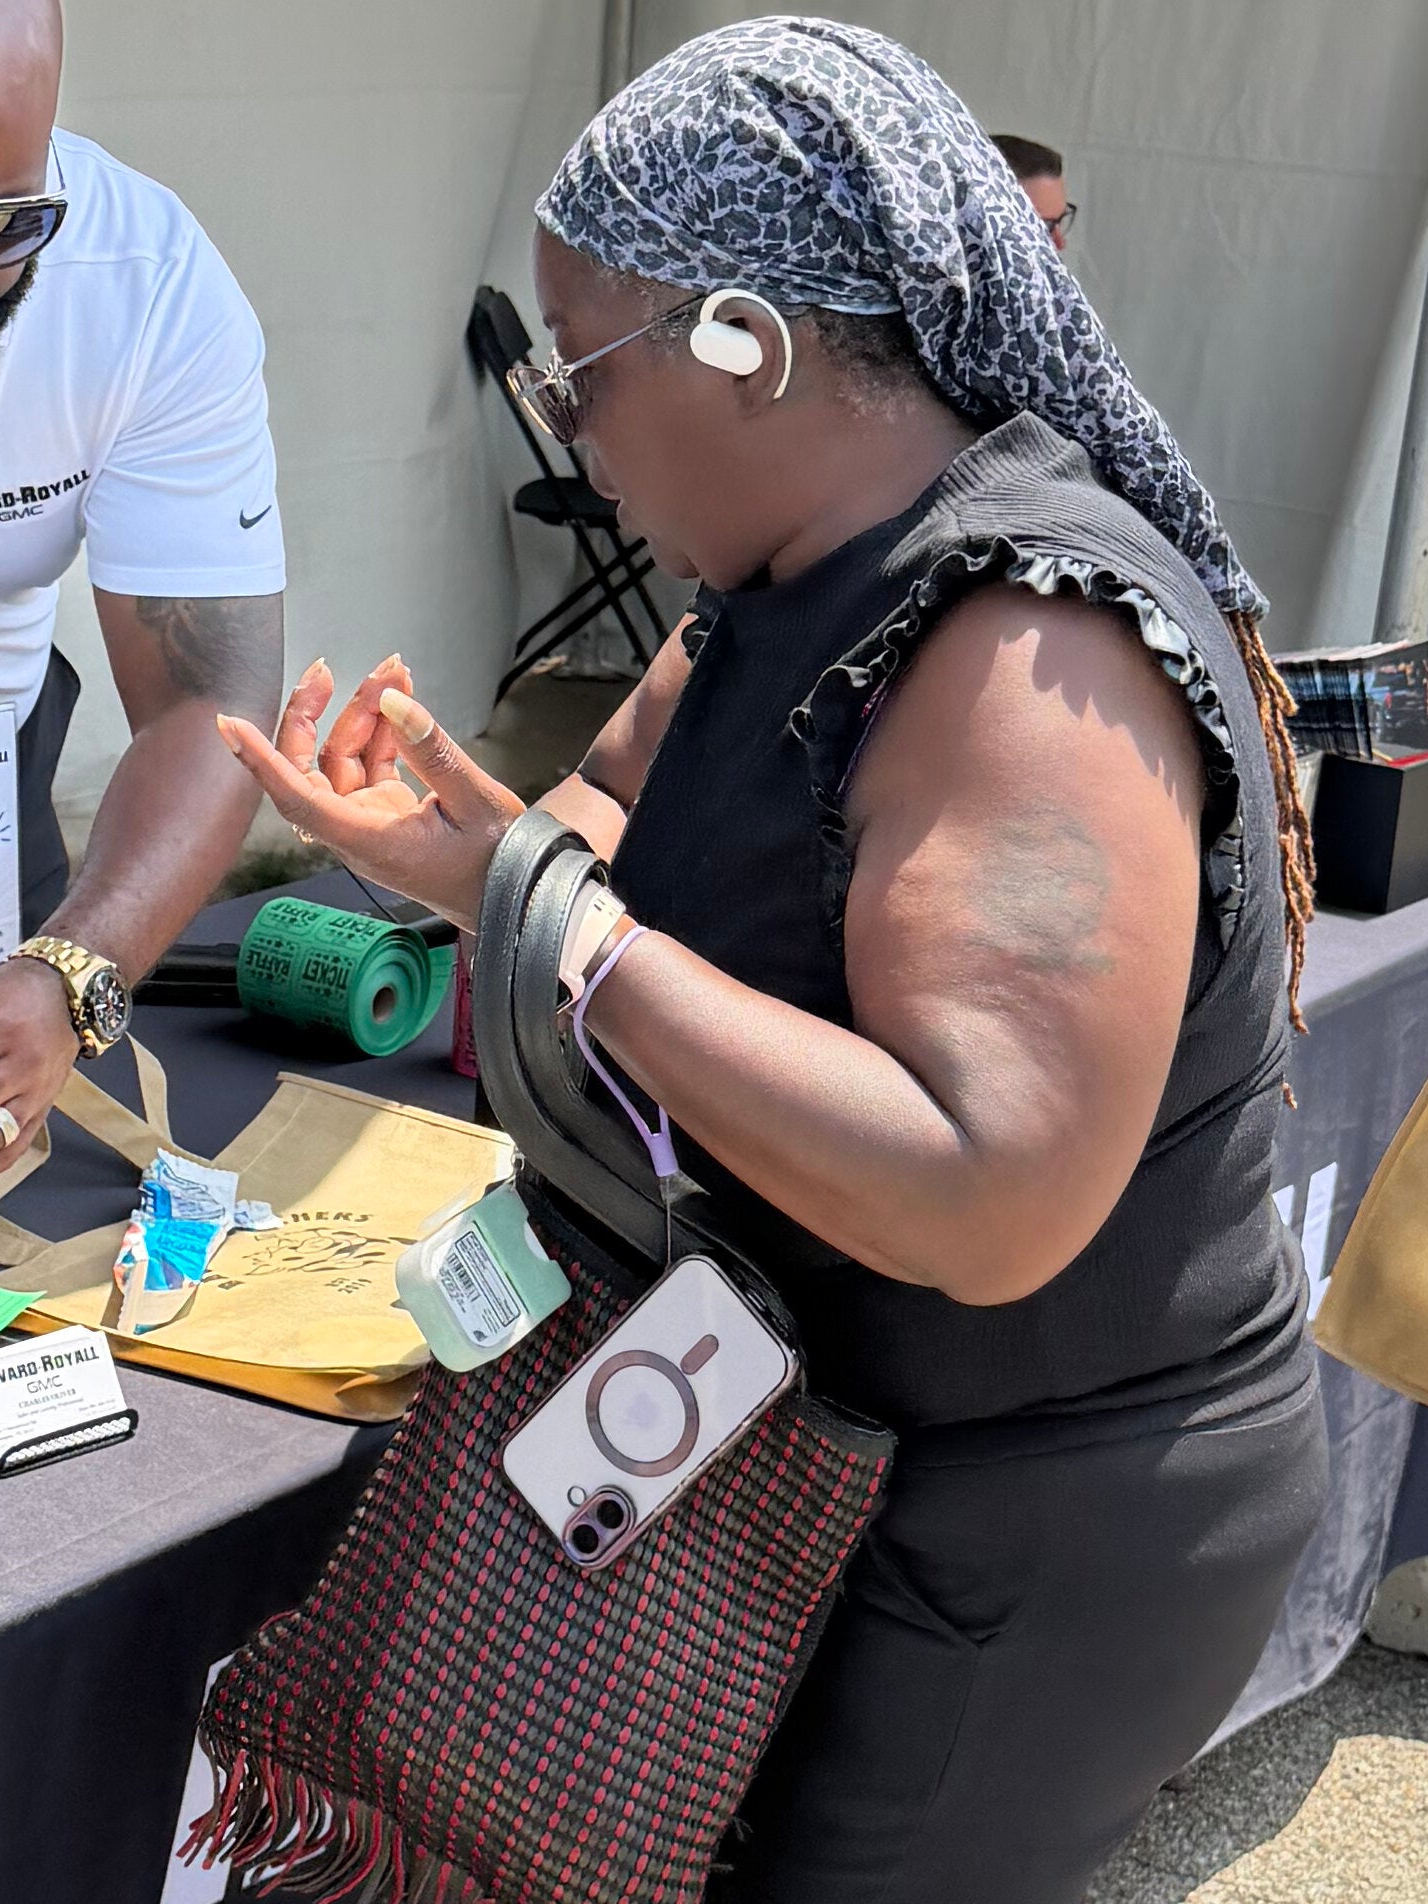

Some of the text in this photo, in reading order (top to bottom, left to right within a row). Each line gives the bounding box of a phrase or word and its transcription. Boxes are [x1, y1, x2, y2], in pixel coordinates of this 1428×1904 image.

[273, 902, 321, 924] RAFFLE
[329, 915, 383, 938] TICKET
[245, 948, 292, 978] RAFFLE
[302, 957, 354, 991] TICKET
[26, 1374, 63, 1394] GMC
